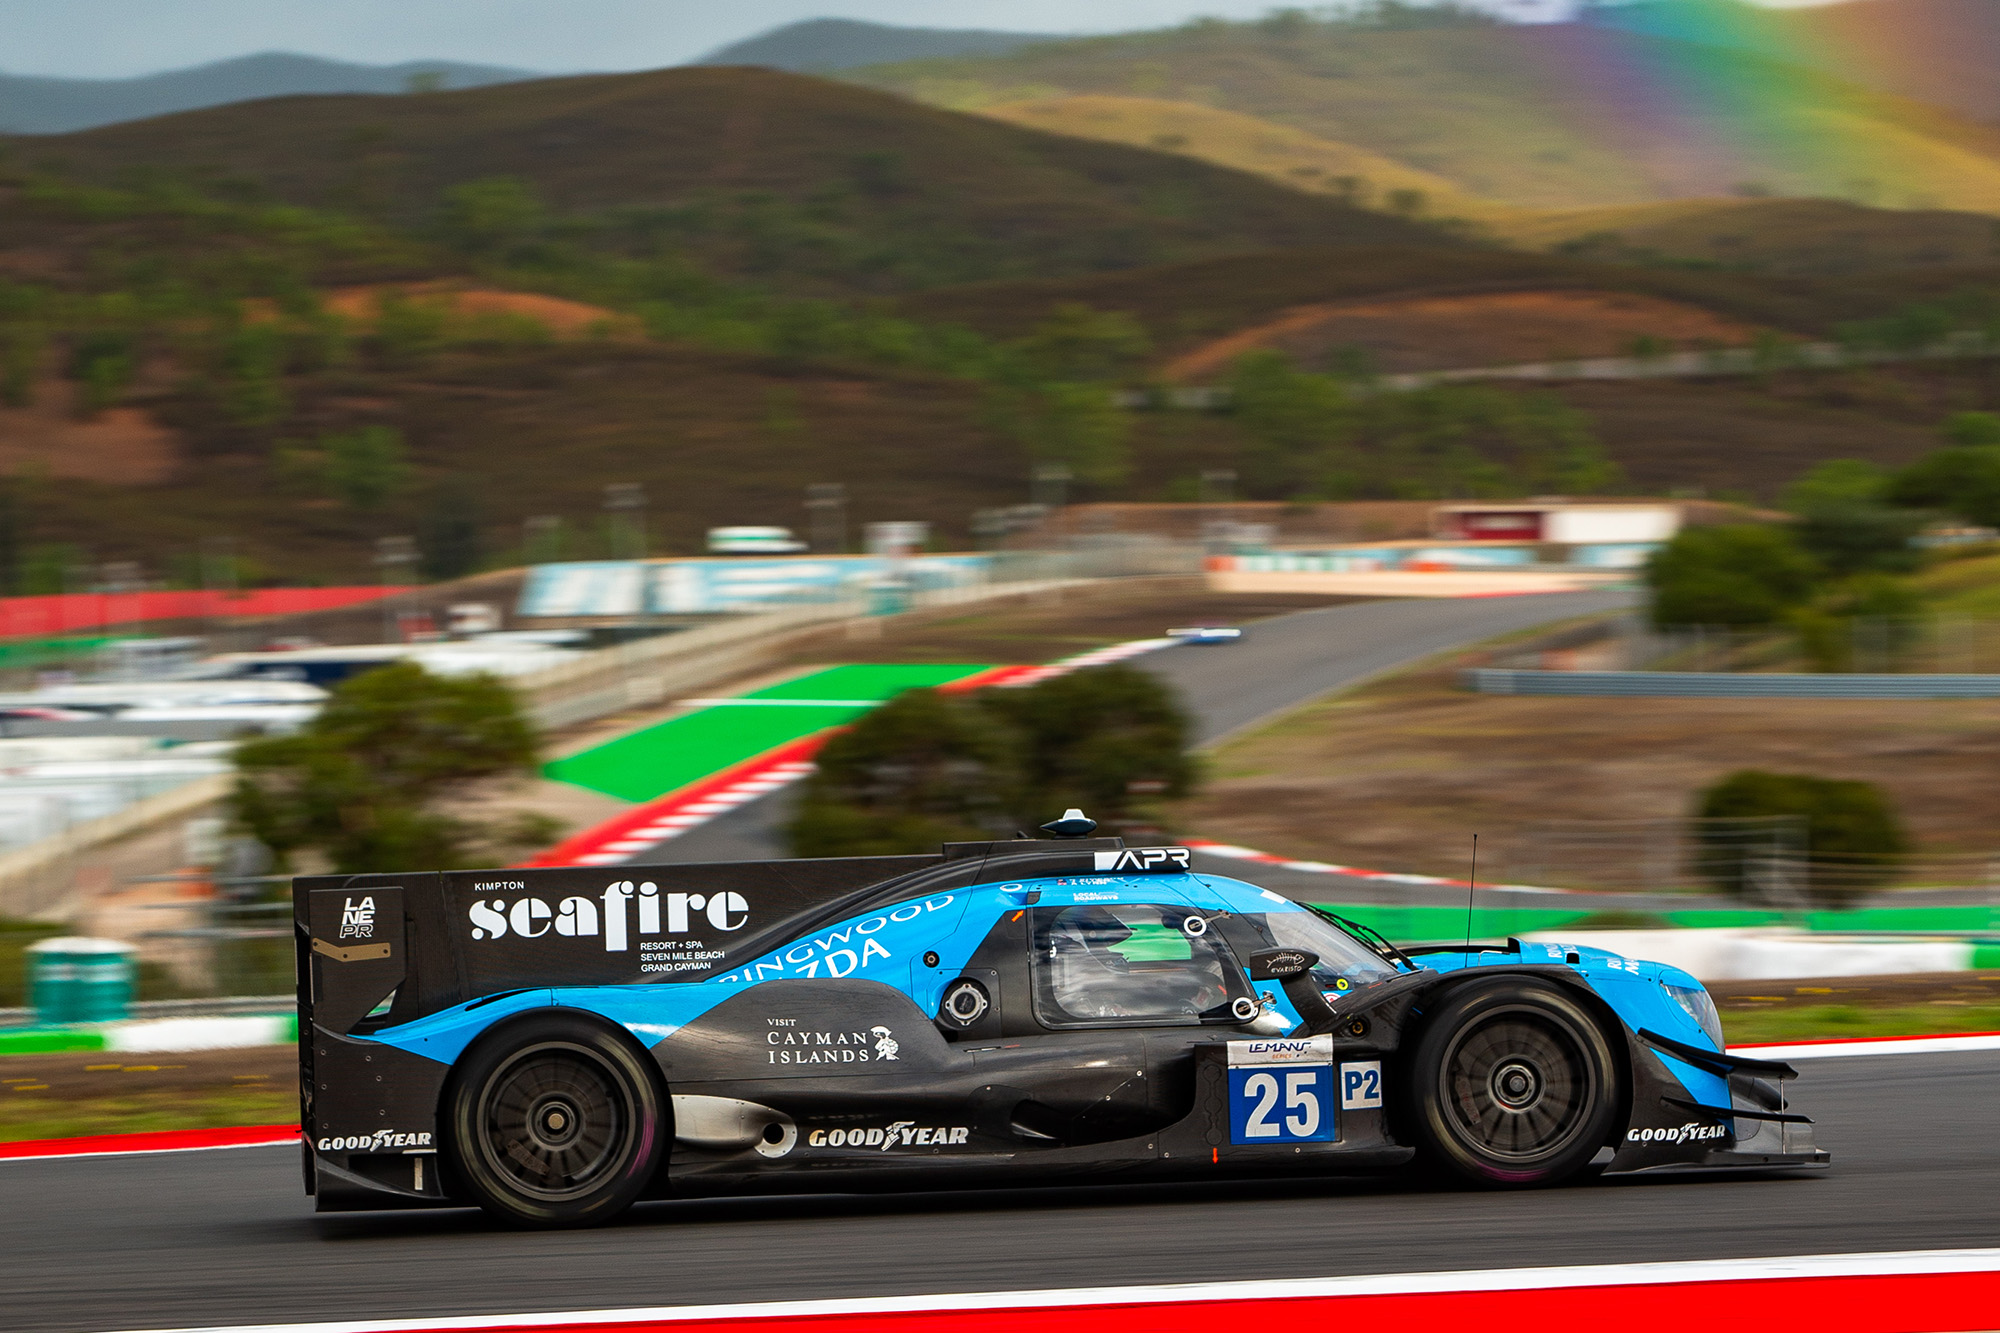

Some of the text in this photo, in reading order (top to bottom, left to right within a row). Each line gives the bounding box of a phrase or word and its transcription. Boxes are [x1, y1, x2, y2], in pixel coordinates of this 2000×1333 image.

[1116, 848, 1190, 870] APR
[474, 881, 525, 892] KIMPTON
[468, 880, 749, 952] seafire
[339, 924, 373, 939] PR
[640, 941, 677, 951] RESORT
[685, 940, 704, 949] SPA
[640, 950, 726, 962] SEVEN MILE BEACH
[640, 961, 712, 973] GRAND CAYMAN
[767, 1018, 797, 1027] VISIT
[767, 1031, 867, 1045] CAYMAN
[768, 1049, 870, 1064] ISLANDS
[1344, 1069, 1380, 1101] P2
[1244, 1072, 1320, 1138] 25
